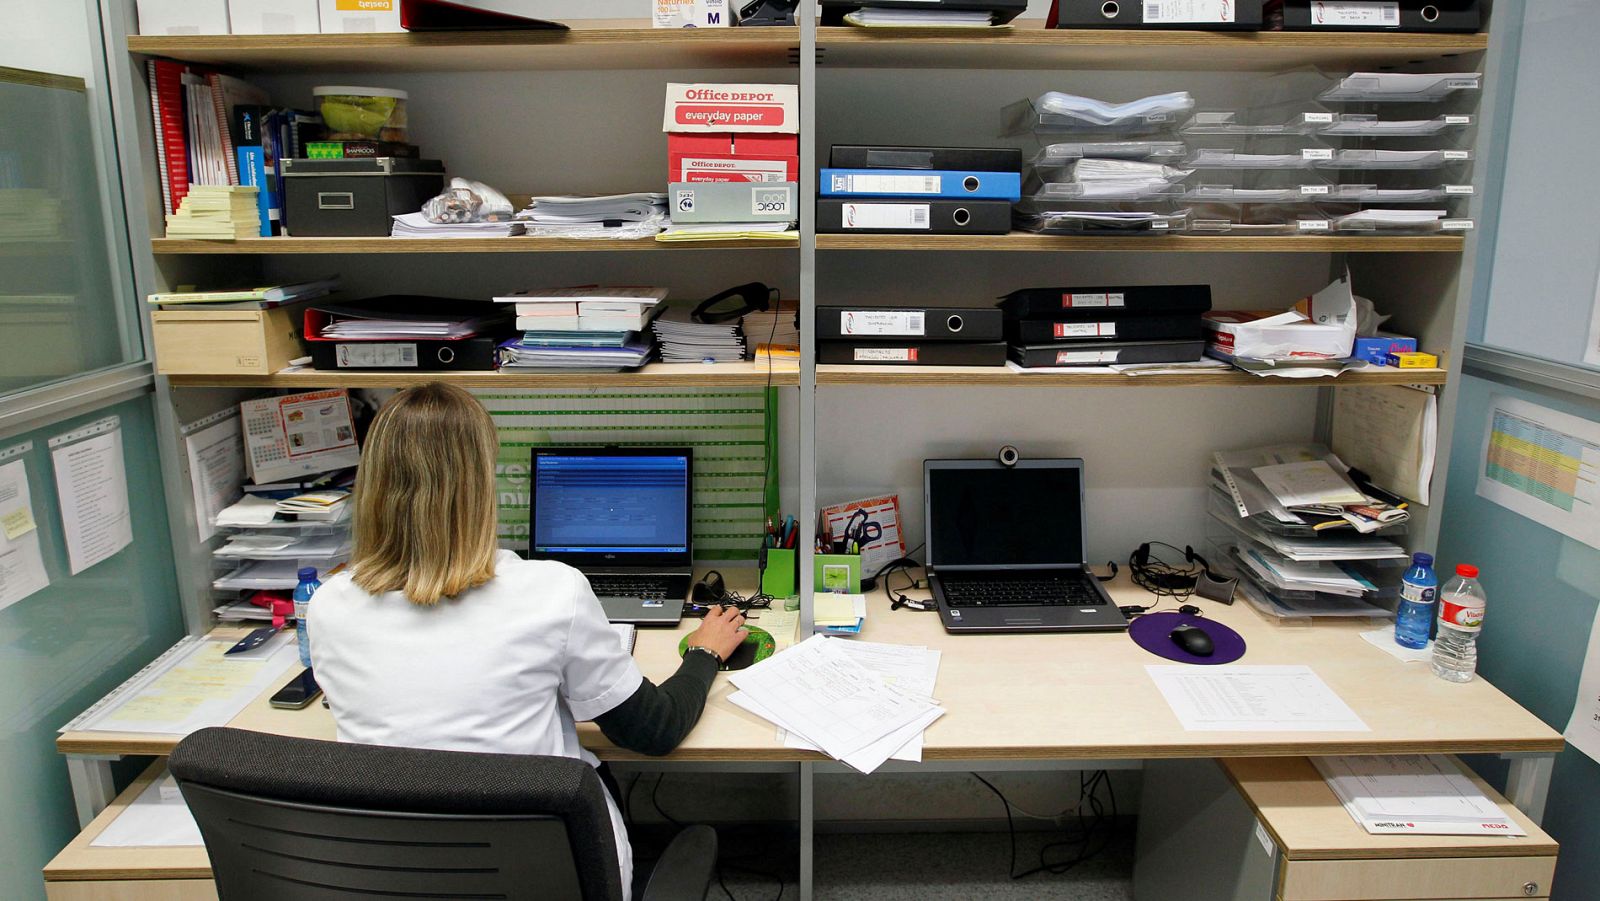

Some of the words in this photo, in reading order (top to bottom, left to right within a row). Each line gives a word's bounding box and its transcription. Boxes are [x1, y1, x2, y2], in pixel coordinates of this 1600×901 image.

[707, 12, 720, 24] M
[685, 88, 729, 101] Office
[731, 93, 774, 101] DEPOT
[685, 110, 731, 123] everyday
[733, 111, 764, 122] paper
[762, 194, 785, 202] 300
[757, 202, 785, 211] LOGIC
